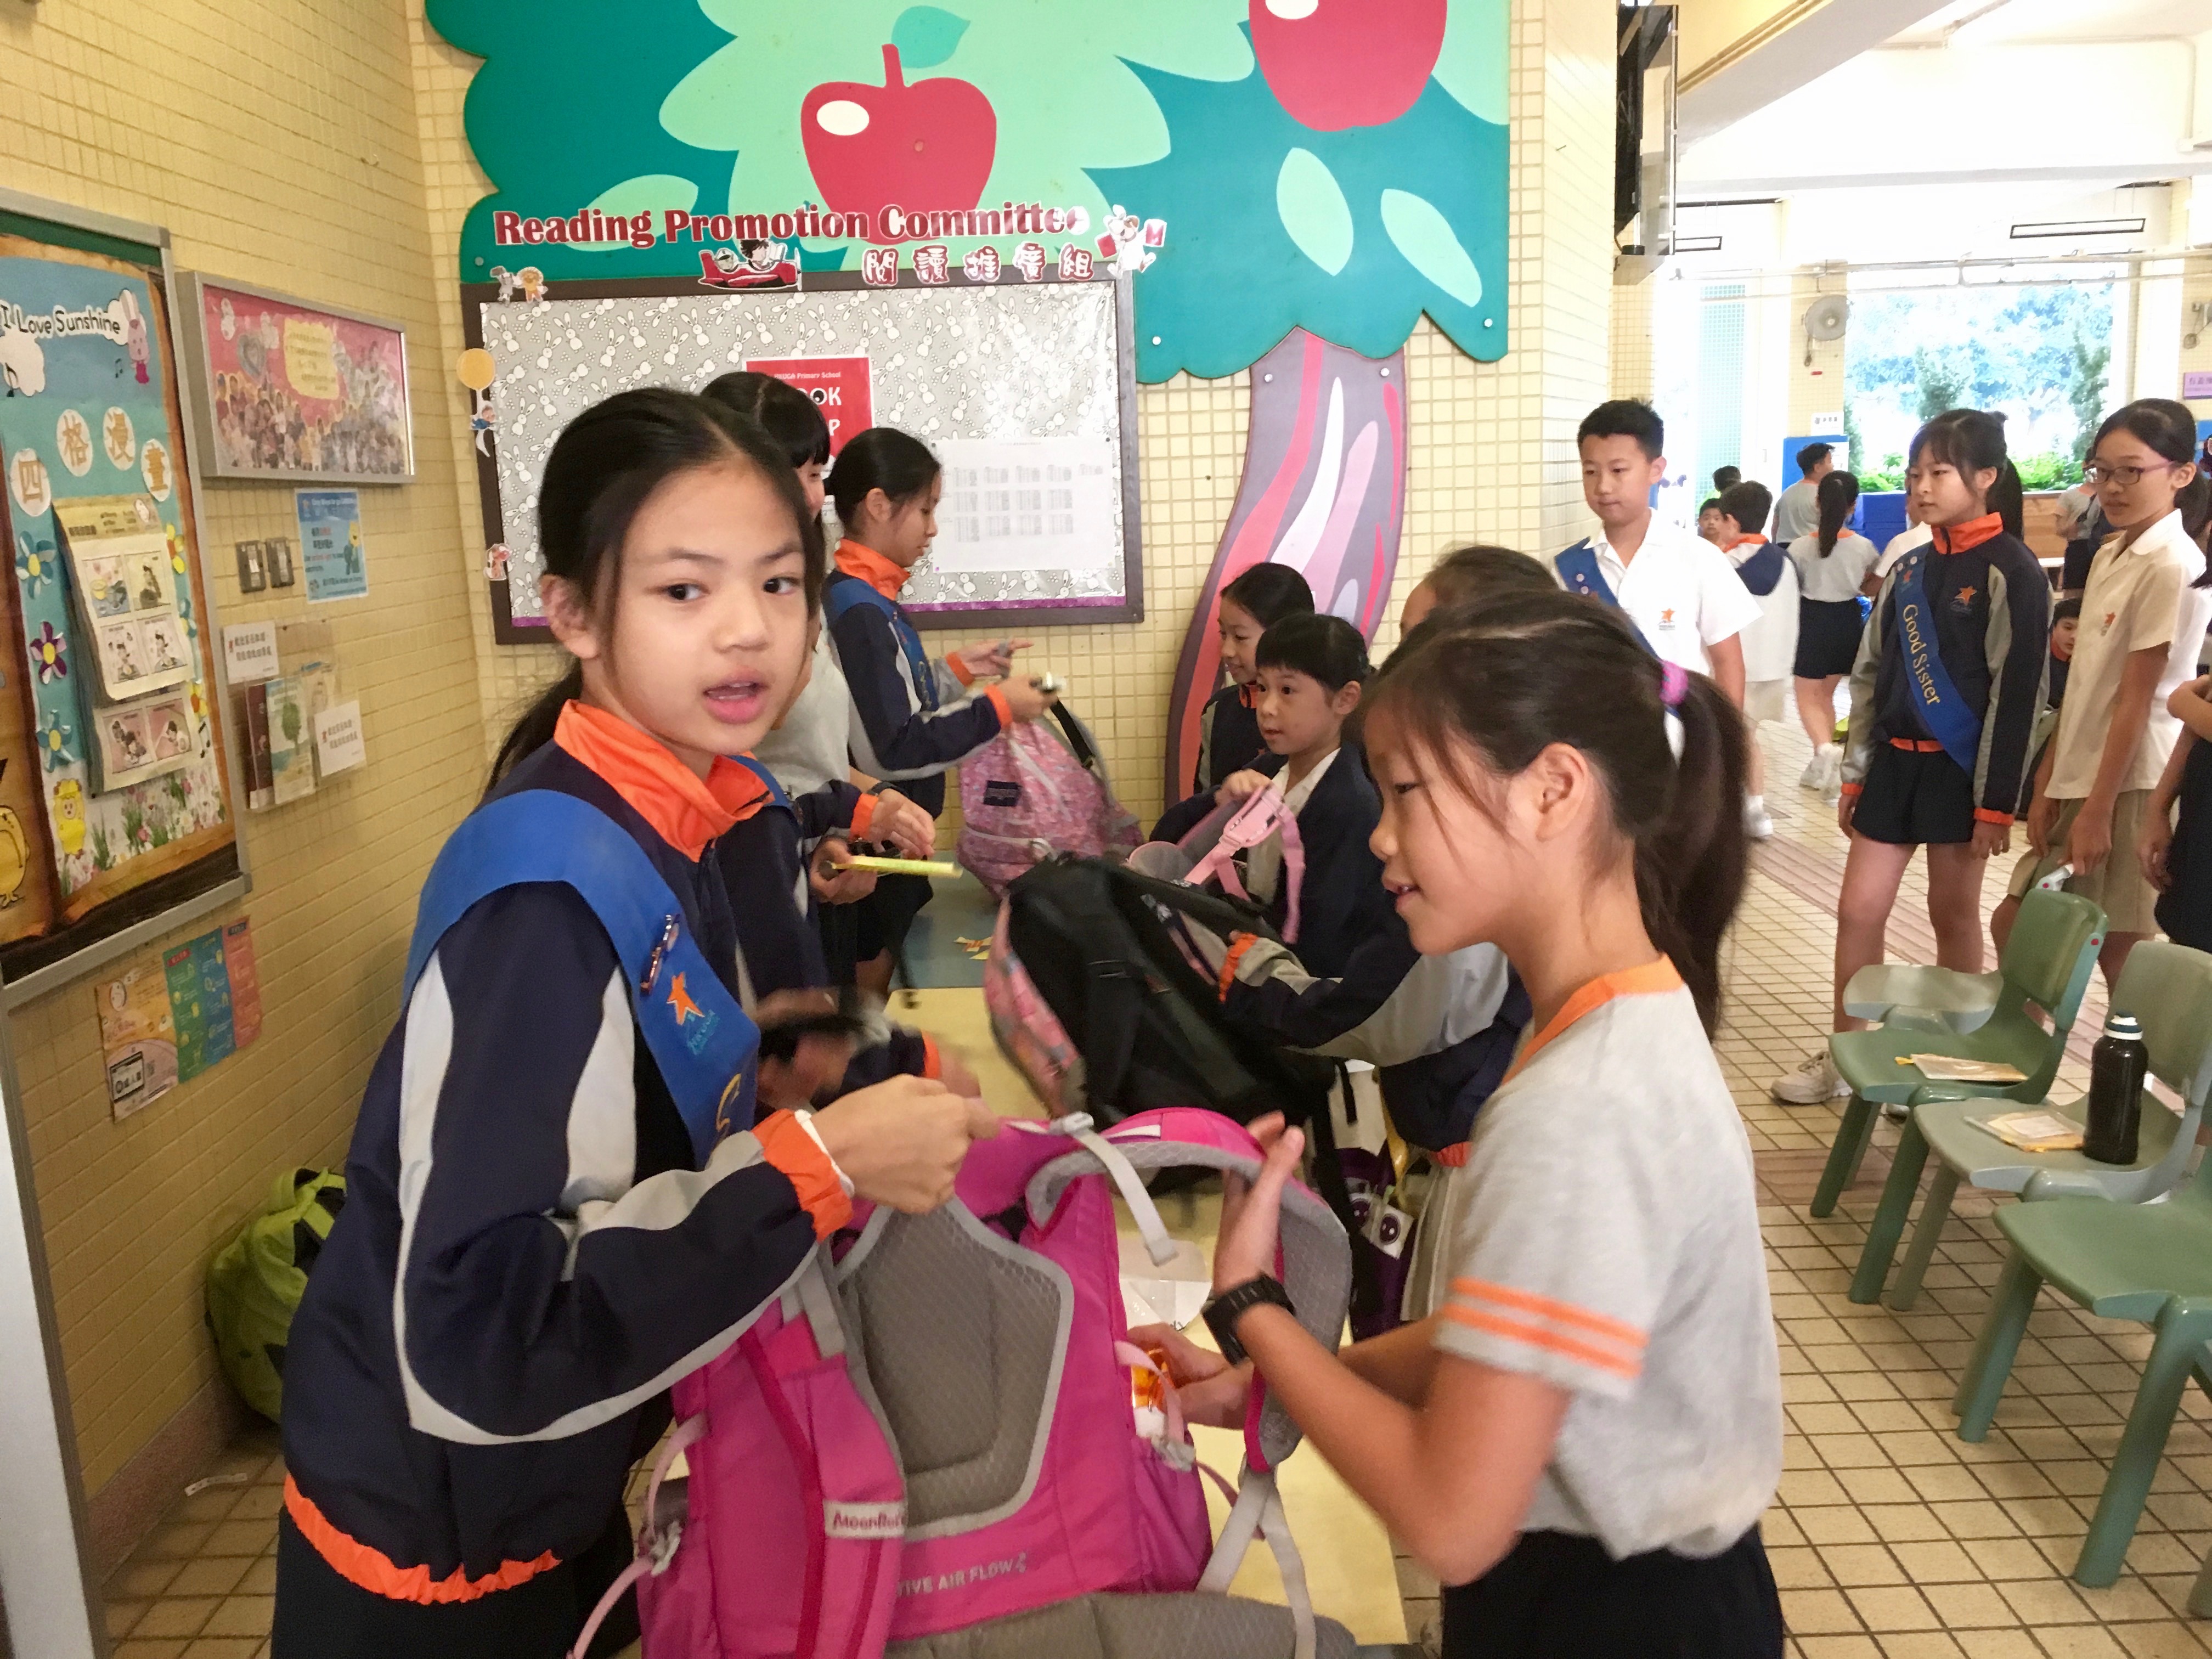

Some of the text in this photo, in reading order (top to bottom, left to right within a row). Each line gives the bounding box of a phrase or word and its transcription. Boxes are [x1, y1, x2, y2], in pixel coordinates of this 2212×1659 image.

[494, 201, 1090, 249] Reading Promotion Committee
[0, 303, 121, 334] I Love Sunshine
[1902, 604, 1940, 706] Good Sister
[938, 1570, 966, 1590] AIR
[969, 1559, 1013, 1583] FLOW
